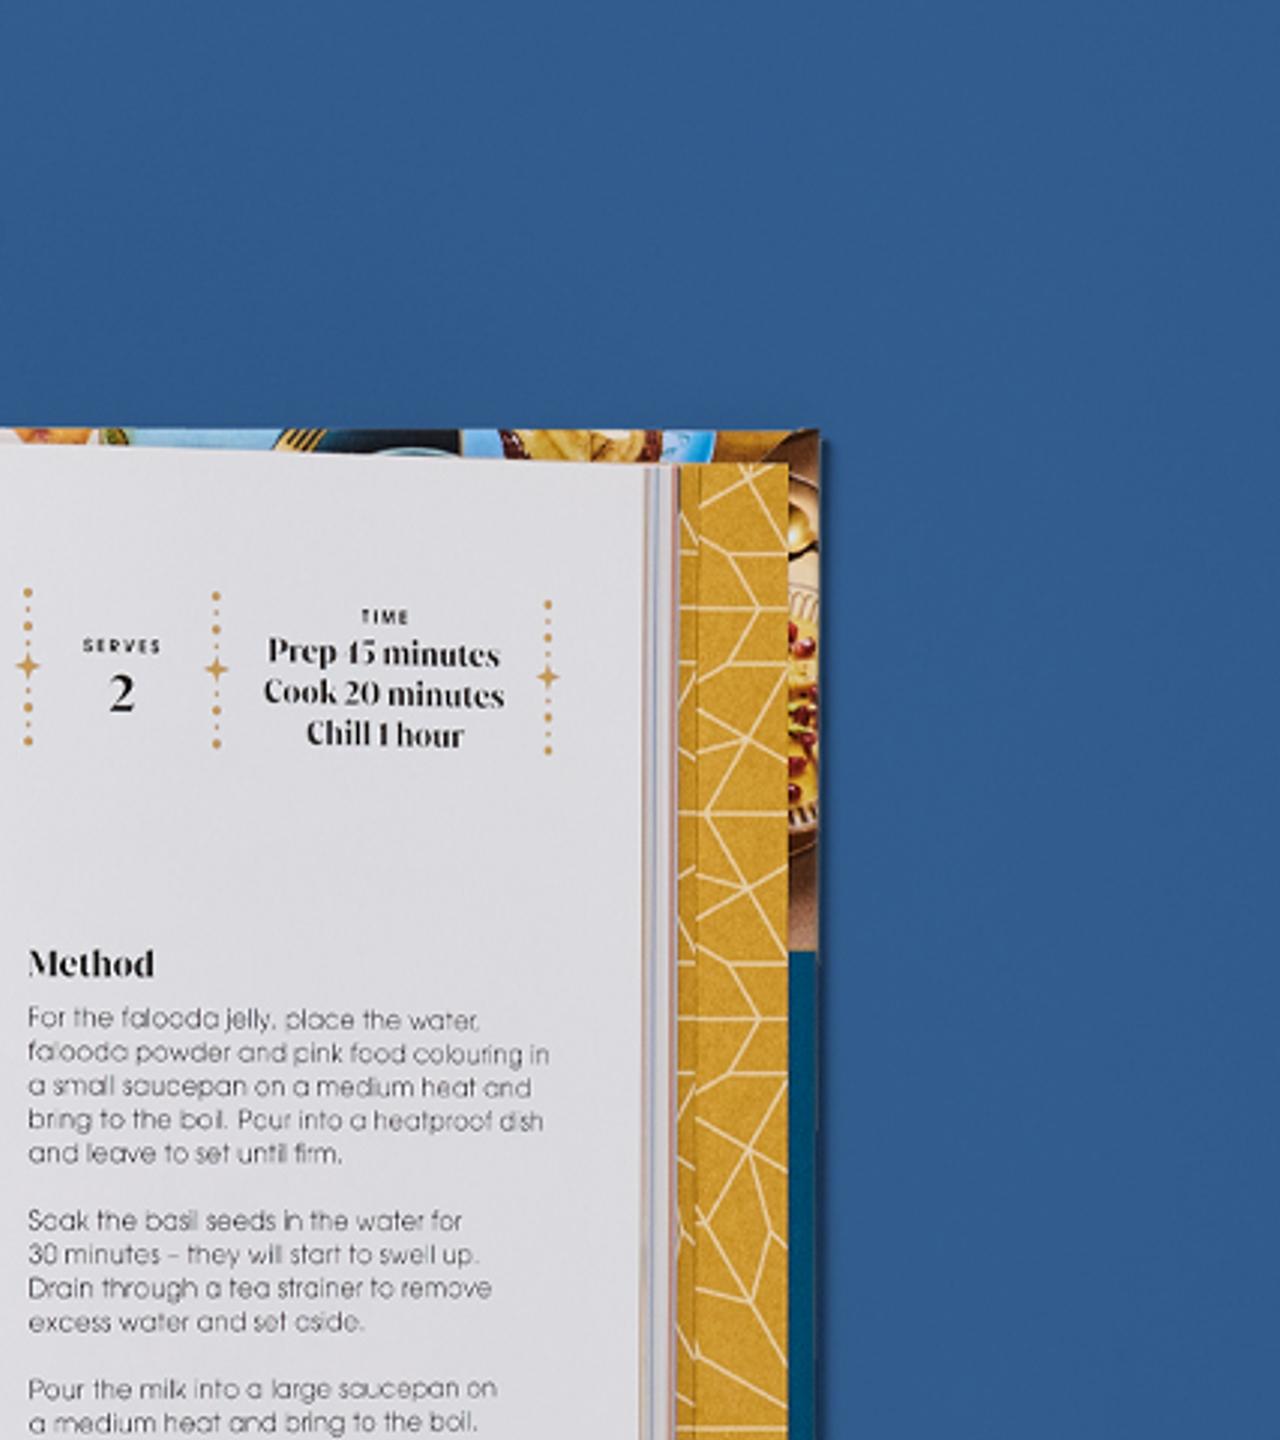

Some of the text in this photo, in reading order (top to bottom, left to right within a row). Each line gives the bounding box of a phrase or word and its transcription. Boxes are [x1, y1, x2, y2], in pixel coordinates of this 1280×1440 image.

[362, 609, 409, 625] TIME
[82, 637, 162, 655] SERVES
[268, 637, 337, 670] Prep
[382, 640, 501, 668] minutes
[109, 674, 135, 713] 2
[264, 678, 505, 709] Cook 20 minutes
[307, 720, 465, 749] Chill 1 hour
[29, 948, 154, 979] Method
[28, 1106, 543, 1137] bring to the boil. Pour into a heatproof dish
[28, 1208, 462, 1233] Soak the basil seeds in the water for
[29, 1274, 492, 1306] Drain through a tea strainer to remove
[28, 1310, 365, 1334] excess water and set aside.
[29, 1377, 498, 1406] Pour the milk into a large saucepan on
